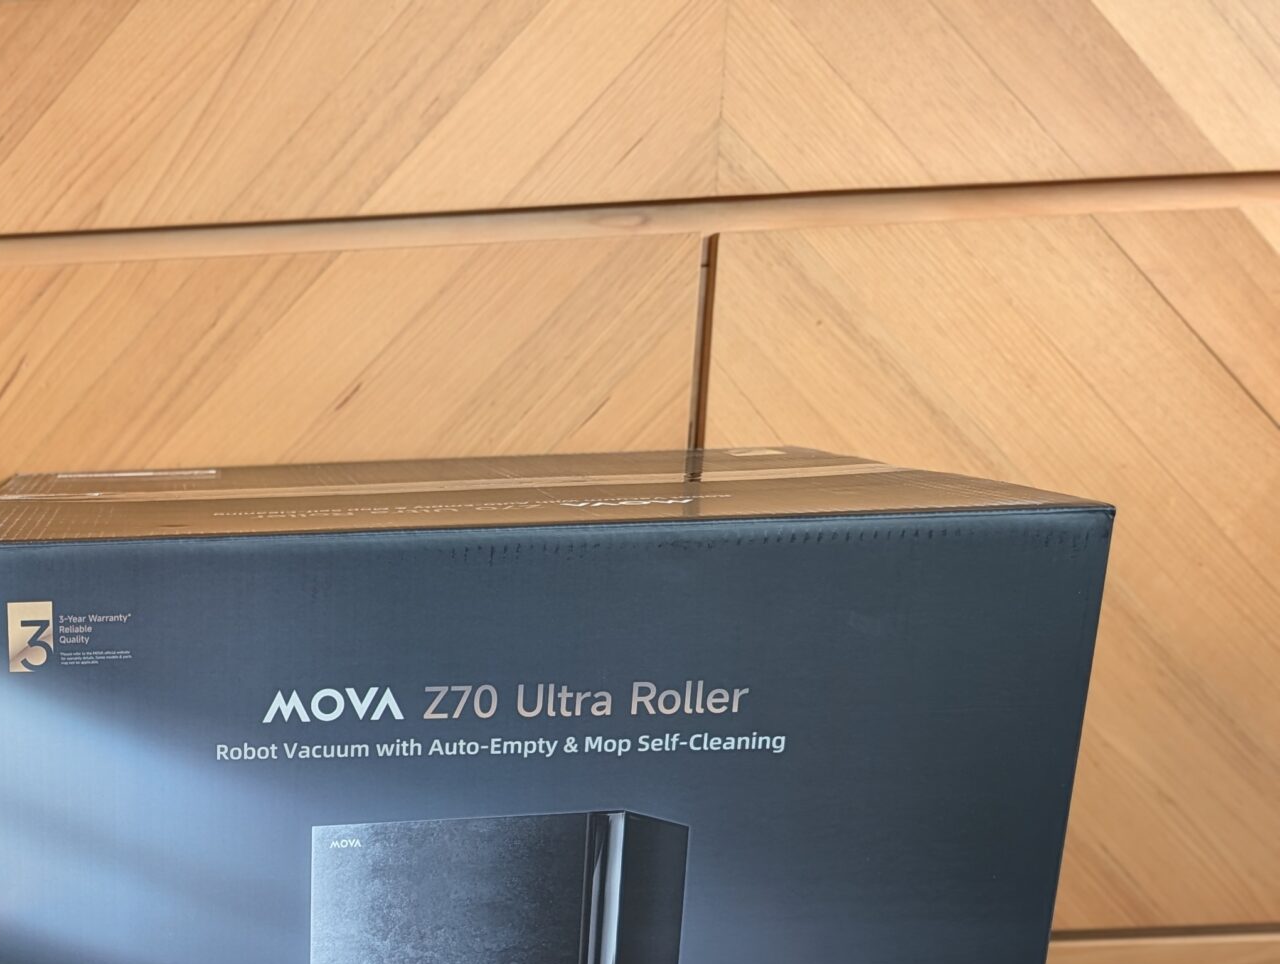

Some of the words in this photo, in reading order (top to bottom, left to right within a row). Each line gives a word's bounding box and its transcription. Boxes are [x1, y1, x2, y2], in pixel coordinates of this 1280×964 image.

[59, 625, 93, 634] Reliable
[59, 635, 90, 645] Quality
[262, 687, 404, 723] MOVA
[423, 685, 498, 720] Z70
[517, 683, 612, 717] Ultra
[631, 680, 750, 715] Roller
[216, 741, 278, 761] Robot
[284, 741, 370, 760] Vacuum
[376, 738, 422, 757] with
[428, 736, 558, 760] Auto-Empty
[563, 736, 579, 755] &
[584, 735, 631, 757] Mop
[637, 731, 786, 755] Self-Cleaning
[329, 838, 362, 848] MOVA
